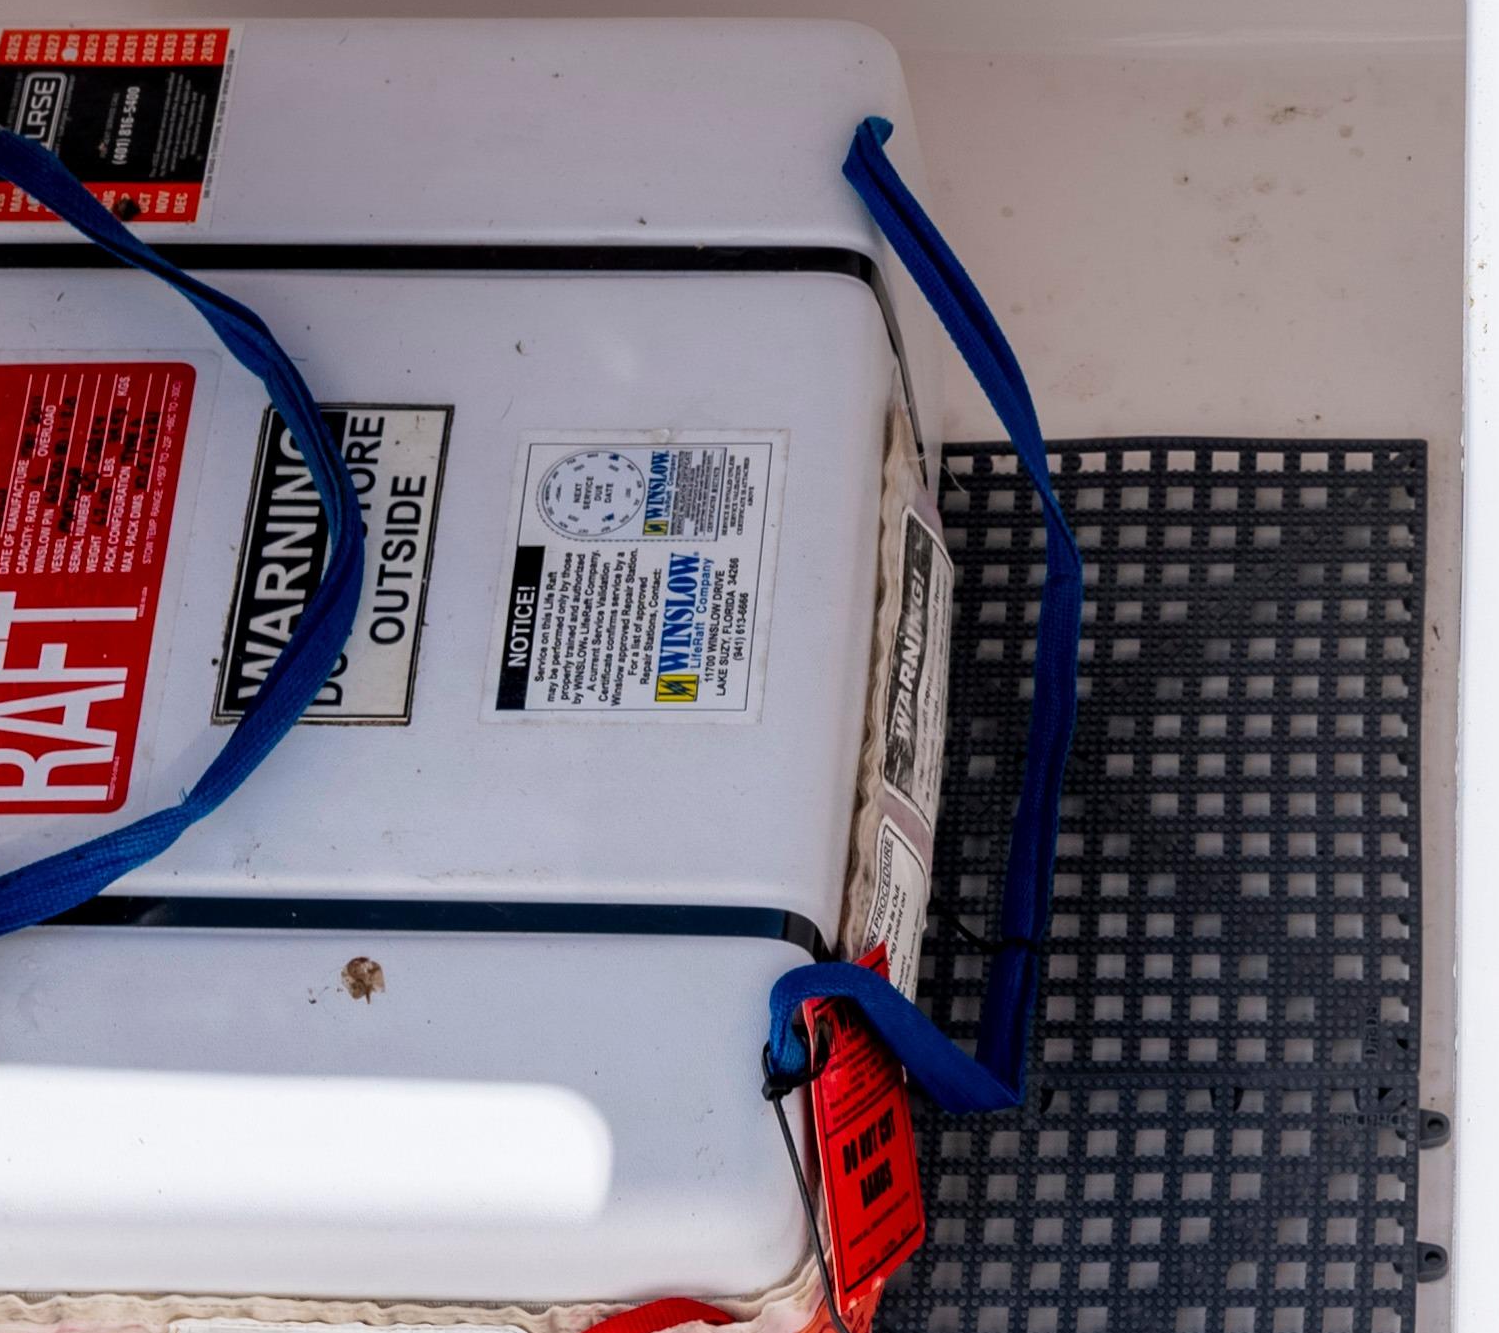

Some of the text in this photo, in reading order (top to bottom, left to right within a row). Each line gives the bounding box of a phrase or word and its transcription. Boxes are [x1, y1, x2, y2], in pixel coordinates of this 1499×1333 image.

[4, 33, 23, 60] 2025
[23, 33, 42, 61] 2026
[42, 34, 62, 61] 2027
[61, 33, 81, 61] 28
[82, 33, 101, 61] 2029
[102, 34, 120, 62] 2030
[121, 34, 139, 62] 2031
[141, 33, 159, 61] 2032
[160, 33, 178, 61] 2033
[179, 33, 198, 61] 2034
[199, 33, 218, 61] 2035
[23, 80, 56, 138] LRSE
[111, 85, 142, 164] (401) 816-5400
[154, 190, 170, 213] NOV
[172, 192, 189, 213] DEC
[37, 404, 56, 456] OVERLOAD
[102, 455, 116, 477] LBS.
[667, 454, 676, 486] Company
[6, 459, 29, 530] MANUFACTURE
[573, 482, 583, 503] NEXT
[582, 475, 594, 510] SERVICE
[594, 484, 603, 501] DUE
[604, 482, 614, 503] DATE
[644, 450, 669, 519] WINSLOW
[74, 494, 91, 535] NUMBER
[107, 465, 131, 543] CONFIGURATION
[3, 533, 15, 546] OF
[15, 490, 41, 573] CAPACITY: RATED
[33, 526, 51, 573] WINSLOW
[124, 519, 139, 546] PACK
[50, 535, 67, 572] VESSEL
[68, 538, 84, 572] SERIAL
[85, 535, 102, 572] WEIGHT
[102, 545, 117, 572] PACK
[367, 475, 426, 645] OUTSIDE
[614, 559, 625, 571] by
[584, 550, 600, 595] Company.
[611, 573, 622, 606] service
[580, 597, 593, 634] LifeRaft
[634, 577, 650, 621] approved
[657, 552, 700, 673] WINSLOW
[690, 558, 714, 668] LifeRaft Company
[722, 590, 736, 634] FLORIDA
[507, 585, 536, 667] NOTICE!
[534, 571, 557, 681] Service on this Life Raft
[547, 552, 573, 701] may be performed only by those
[559, 553, 586, 700] properly trained and authorized
[586, 561, 610, 691] A current Service Validation
[604, 609, 618, 651] confirms
[611, 547, 638, 706] Winslow approved Repair Station.
[630, 634, 641, 648] list
[632, 623, 642, 632] of
[639, 568, 662, 684] Repair Stations, Contact:
[703, 570, 724, 681] 11700 WINSLOW DRIVE
[732, 592, 749, 660] (941) 613-6666
[628, 660, 638, 675] For
[719, 637, 732, 665] SUZY,
[894, 568, 926, 740] WARNING!
[598, 653, 613, 701] Certificate
[715, 668, 727, 696] LAKE
[571, 692, 583, 704] by
[874, 835, 894, 927] PROCEDURE
